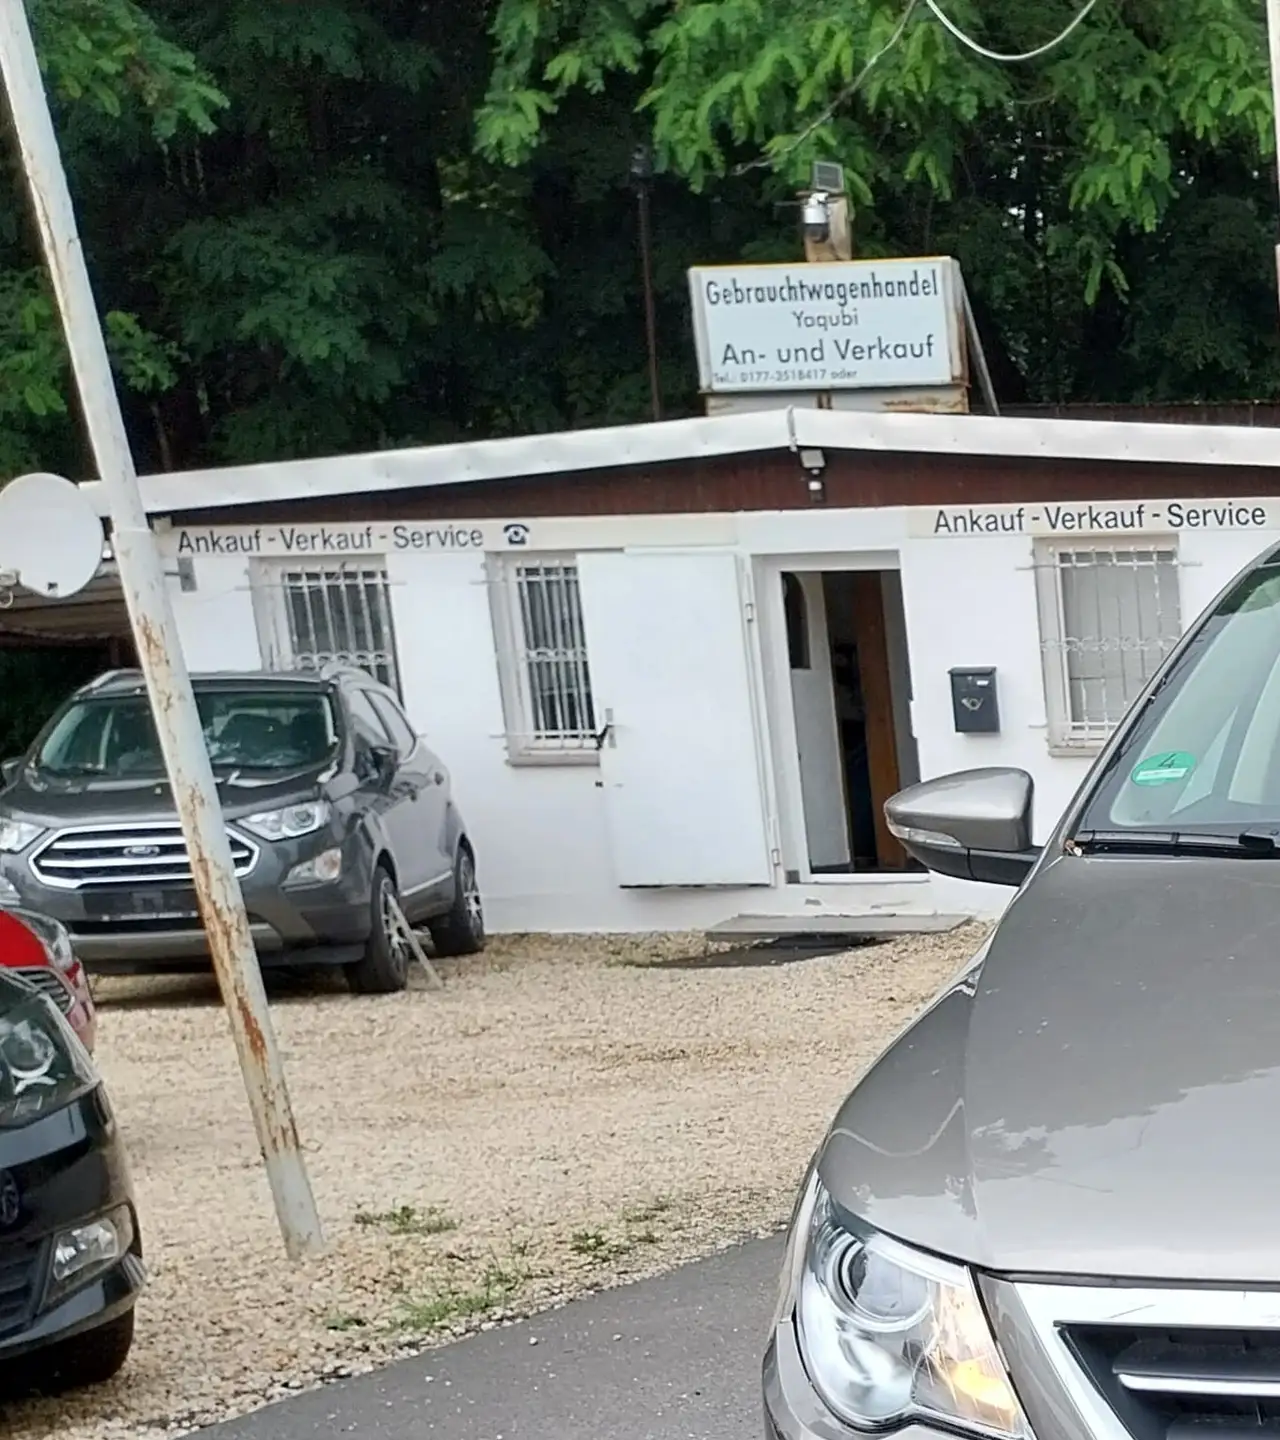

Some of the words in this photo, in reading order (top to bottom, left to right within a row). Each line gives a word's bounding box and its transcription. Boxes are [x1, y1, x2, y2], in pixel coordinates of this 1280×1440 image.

[706, 269, 939, 307] Gebrauchtwagenhandel
[791, 307, 859, 331] Yaqubi
[721, 343, 767, 366] An-
[777, 338, 824, 364] und
[834, 334, 934, 361] Verkauf
[934, 508, 1026, 533] Ankauf
[1044, 503, 1146, 531] Verkauf
[1167, 501, 1266, 527] Service
[178, 528, 263, 553] Ankauf
[279, 526, 373, 550] Verkauf
[393, 524, 483, 549] Service
[1157, 753, 1176, 768] 4
